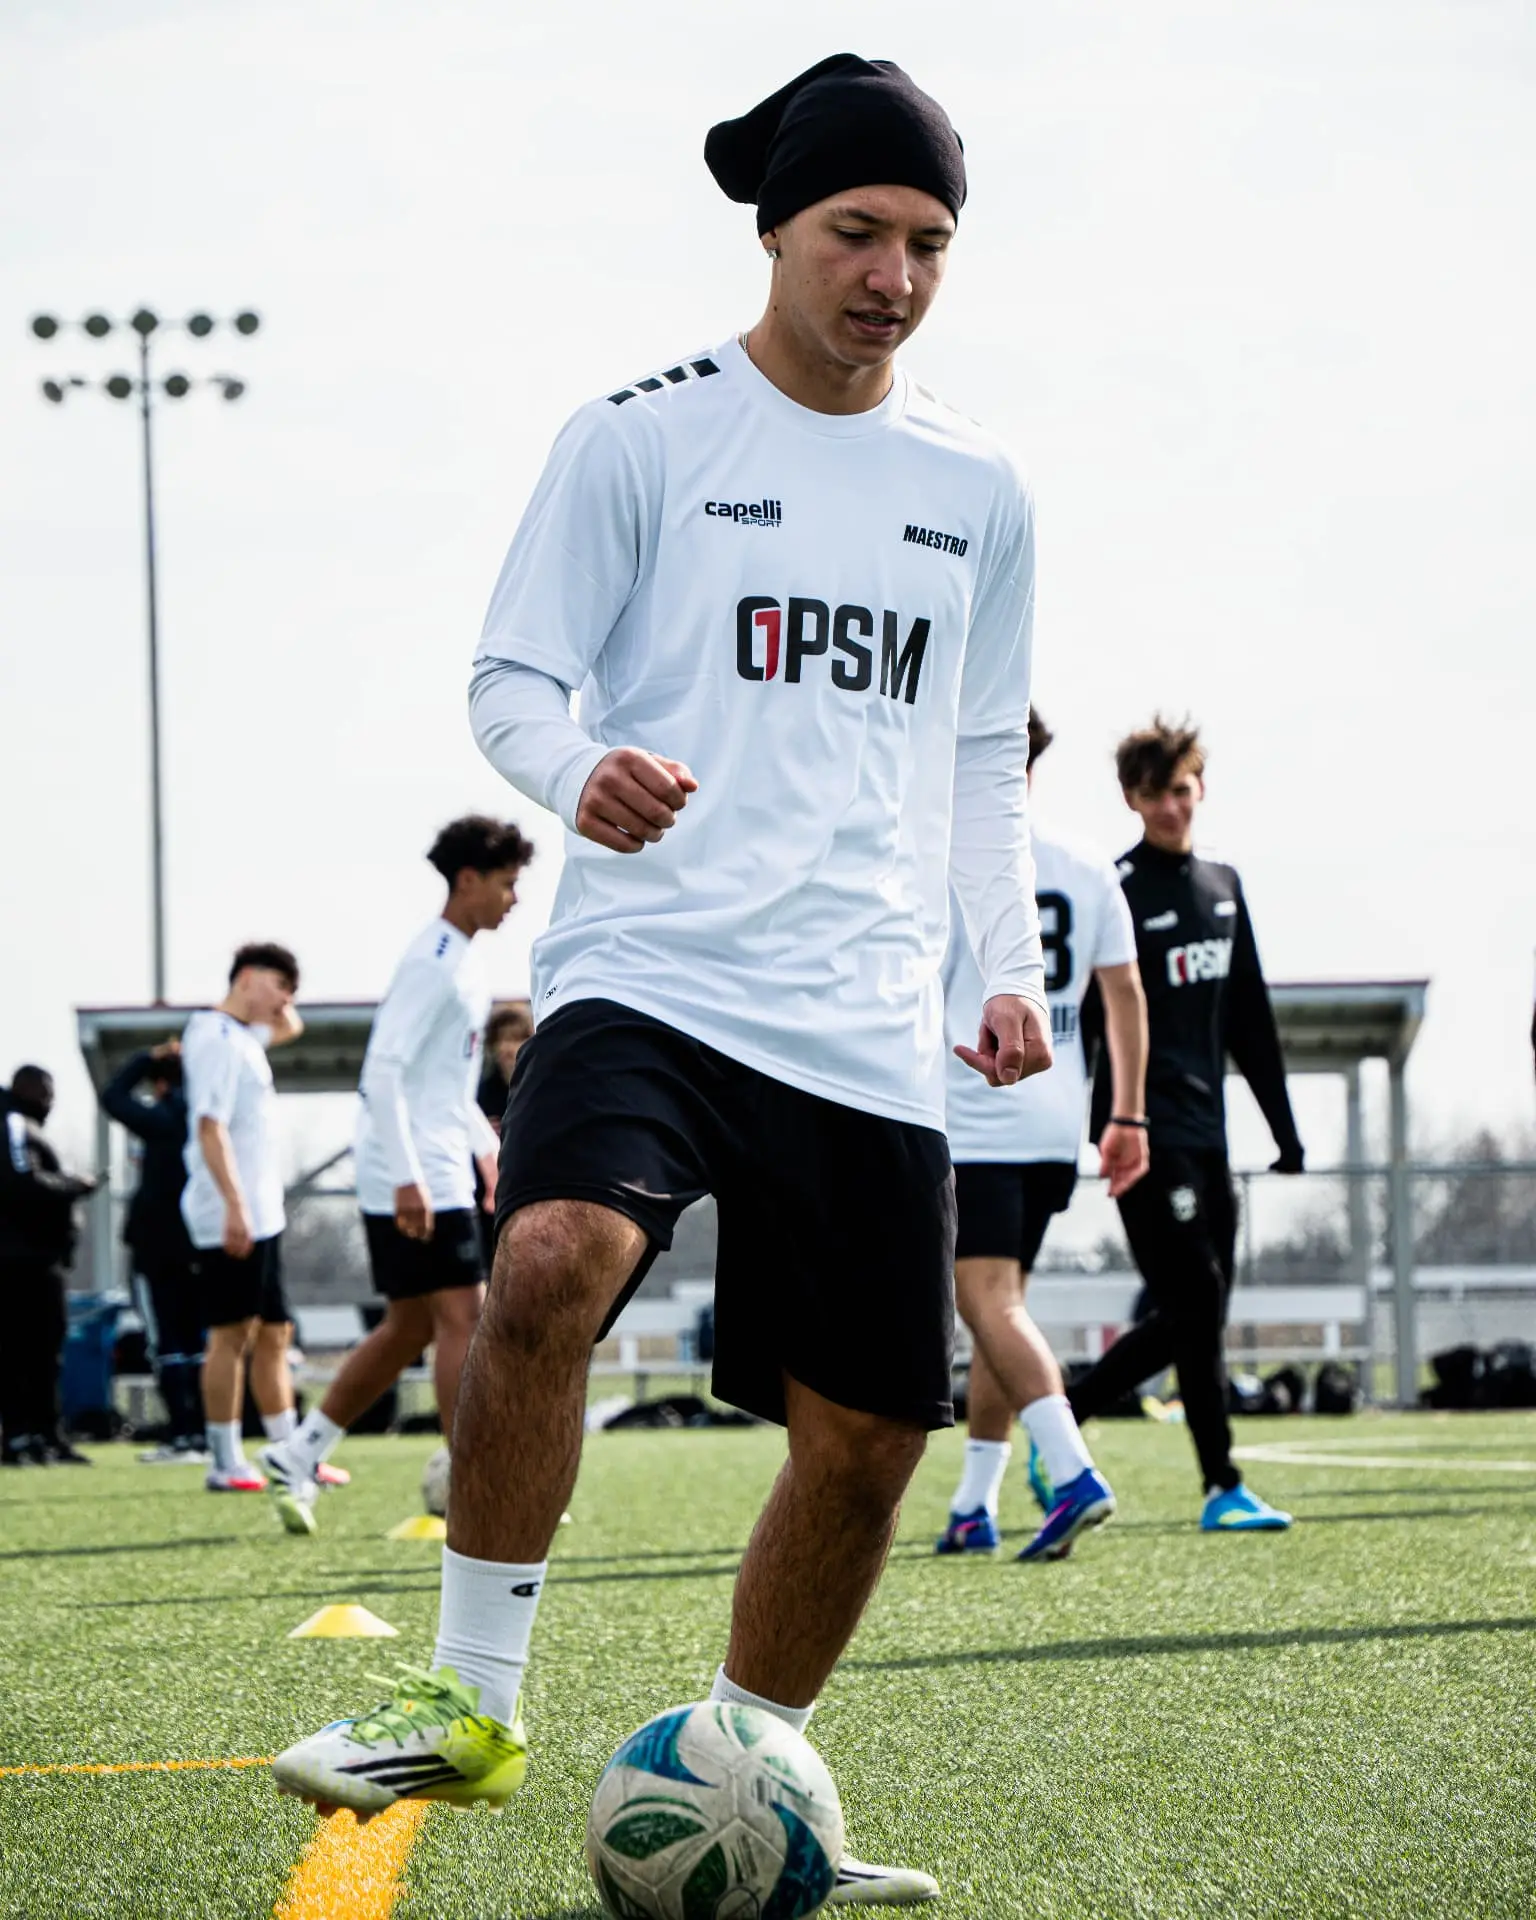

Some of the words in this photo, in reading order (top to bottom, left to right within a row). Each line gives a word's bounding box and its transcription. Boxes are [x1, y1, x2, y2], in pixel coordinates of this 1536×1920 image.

[704, 499, 782, 523] capelli
[741, 517, 782, 528] SPORT
[903, 524, 969, 557] MAESTRO
